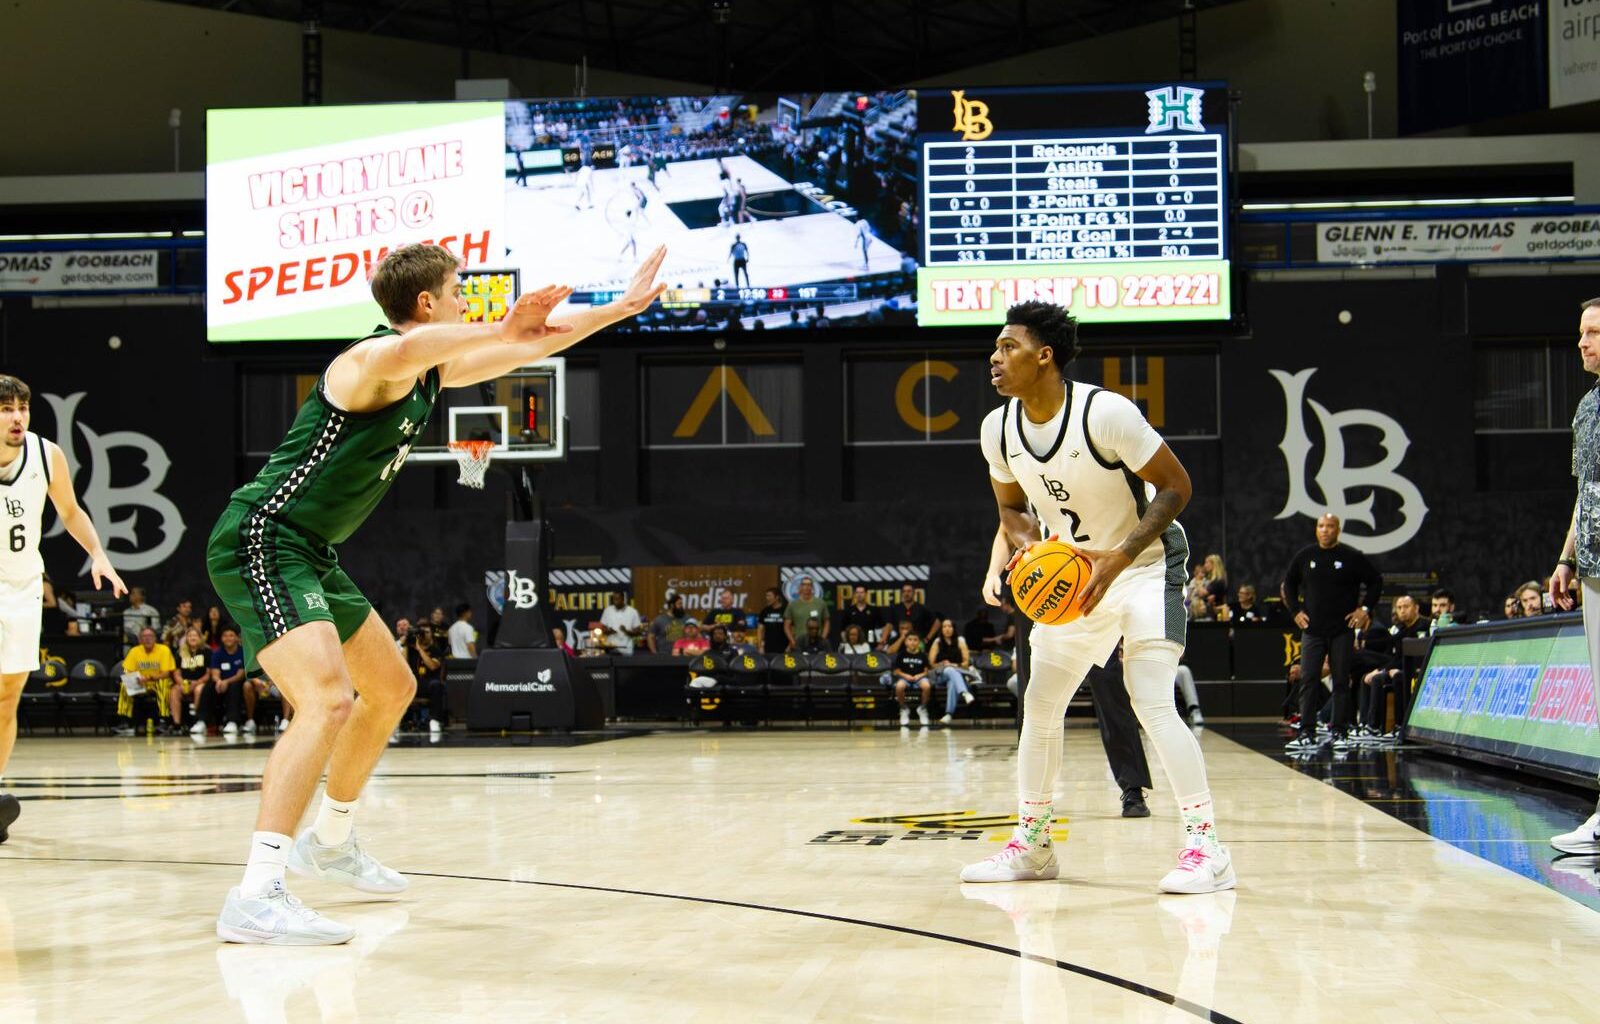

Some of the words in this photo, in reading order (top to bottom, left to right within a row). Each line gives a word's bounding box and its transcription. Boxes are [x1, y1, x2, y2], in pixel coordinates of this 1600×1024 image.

[1403, 29, 1428, 45] Port
[1430, 22, 1442, 40] of
[1447, 15, 1486, 36] LONG
[1491, 3, 1540, 27] BEACH
[966, 146, 976, 159] 2
[1032, 142, 1117, 158] Rebounds
[1168, 141, 1179, 154] 2
[965, 162, 976, 175] 0
[1045, 160, 1103, 174] Assists
[1168, 158, 1179, 169] 0
[248, 152, 385, 210] VICTORY
[387, 139, 464, 188] LANE
[1168, 174, 1179, 188] 0
[965, 180, 976, 193] 0
[1047, 177, 1099, 190] Steals
[950, 198, 960, 211] 0
[979, 197, 990, 211] 0
[1028, 195, 1090, 209] 3-Point
[1093, 193, 1118, 207] FG
[1155, 192, 1166, 205] 0
[1183, 191, 1194, 204] 0
[278, 196, 397, 250] STARTS
[400, 190, 435, 230] @
[960, 214, 982, 228] 0.0
[1020, 212, 1081, 227] 3-Point
[1085, 211, 1110, 226] FG
[1113, 211, 1129, 225] %
[1164, 208, 1186, 223] 0.0
[979, 232, 989, 245] 3
[1030, 229, 1073, 243] Field
[1077, 228, 1116, 242] Goal
[1158, 227, 1168, 241] 2
[1183, 226, 1194, 239] 4
[1325, 225, 1396, 242] GLENN
[1402, 224, 1419, 240] E.
[1427, 222, 1515, 240] THOMAS
[1025, 245, 1068, 260] Field
[1071, 245, 1110, 259] Goal
[1113, 244, 1130, 258] %
[65, 253, 154, 269] #GOBEACH
[61, 271, 154, 285] getdodge.com
[931, 278, 995, 312] TEXT
[1081, 276, 1119, 308] TO
[1060, 507, 1091, 543] 2
[9, 524, 26, 553] 6
[667, 577, 744, 588] Courtside
[1032, 578, 1073, 619] Wilson
[485, 681, 555, 692] MemorialCare
